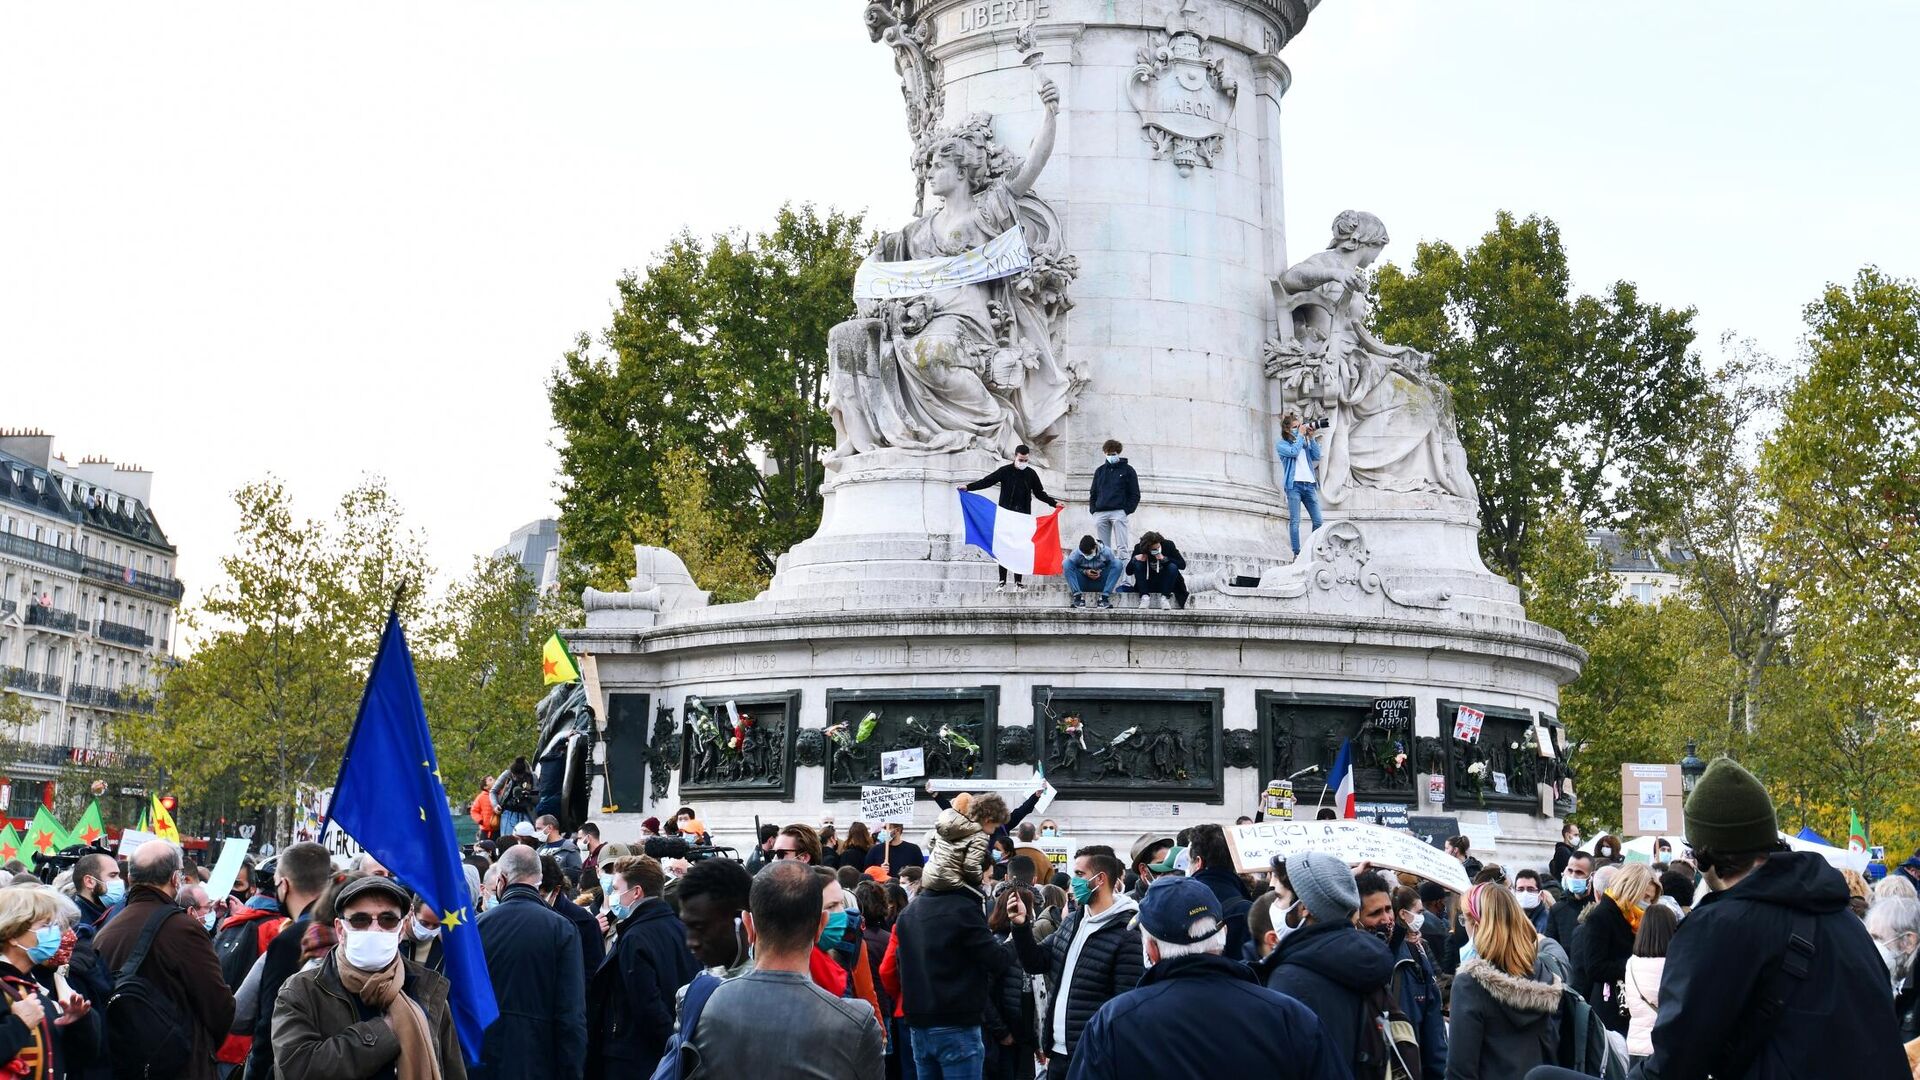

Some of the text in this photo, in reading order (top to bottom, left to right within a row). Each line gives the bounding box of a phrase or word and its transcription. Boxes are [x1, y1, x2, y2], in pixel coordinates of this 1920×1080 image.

[867, 648, 933, 665] JUILLET
[1298, 653, 1362, 672] JUILLET
[1366, 658, 1398, 674] 1790
[1375, 700, 1409, 710] COUVRE
[1382, 709, 1400, 718] FEU
[1268, 808, 1284, 816] POUR
[1239, 824, 1308, 839] MERCI
